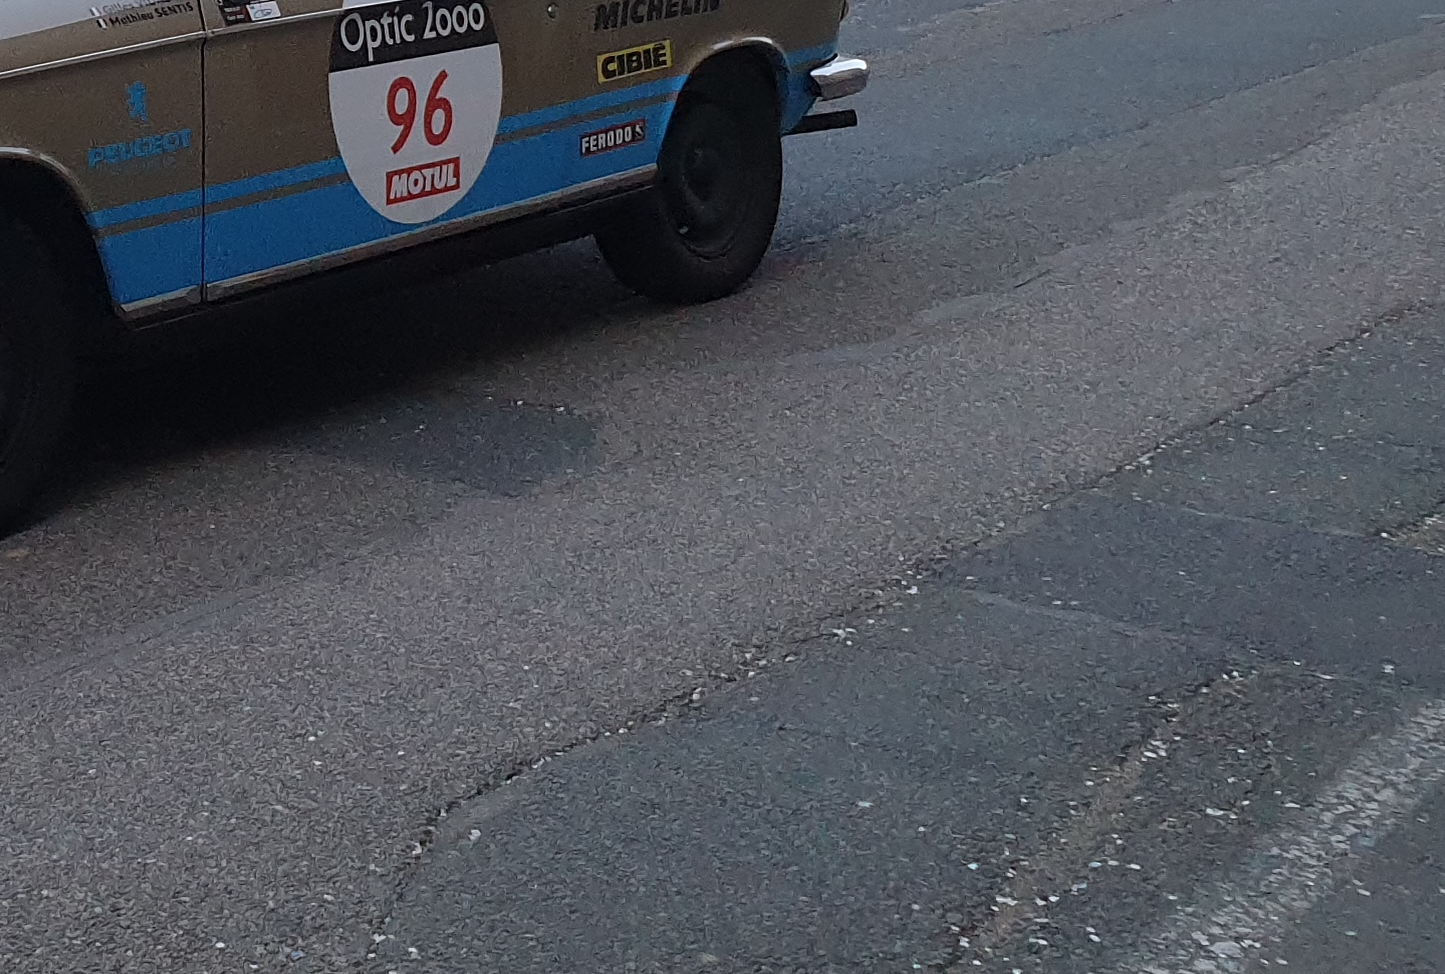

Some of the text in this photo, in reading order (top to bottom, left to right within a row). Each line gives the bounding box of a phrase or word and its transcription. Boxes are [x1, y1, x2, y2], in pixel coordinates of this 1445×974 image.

[109, 1, 194, 27] Mathieu SENTIS
[340, 1, 485, 62] Optic 2000
[386, 69, 452, 154] 96
[87, 128, 193, 169] PEUGEOT
[581, 126, 631, 154] FERODO
[389, 163, 457, 200] MOTUL
